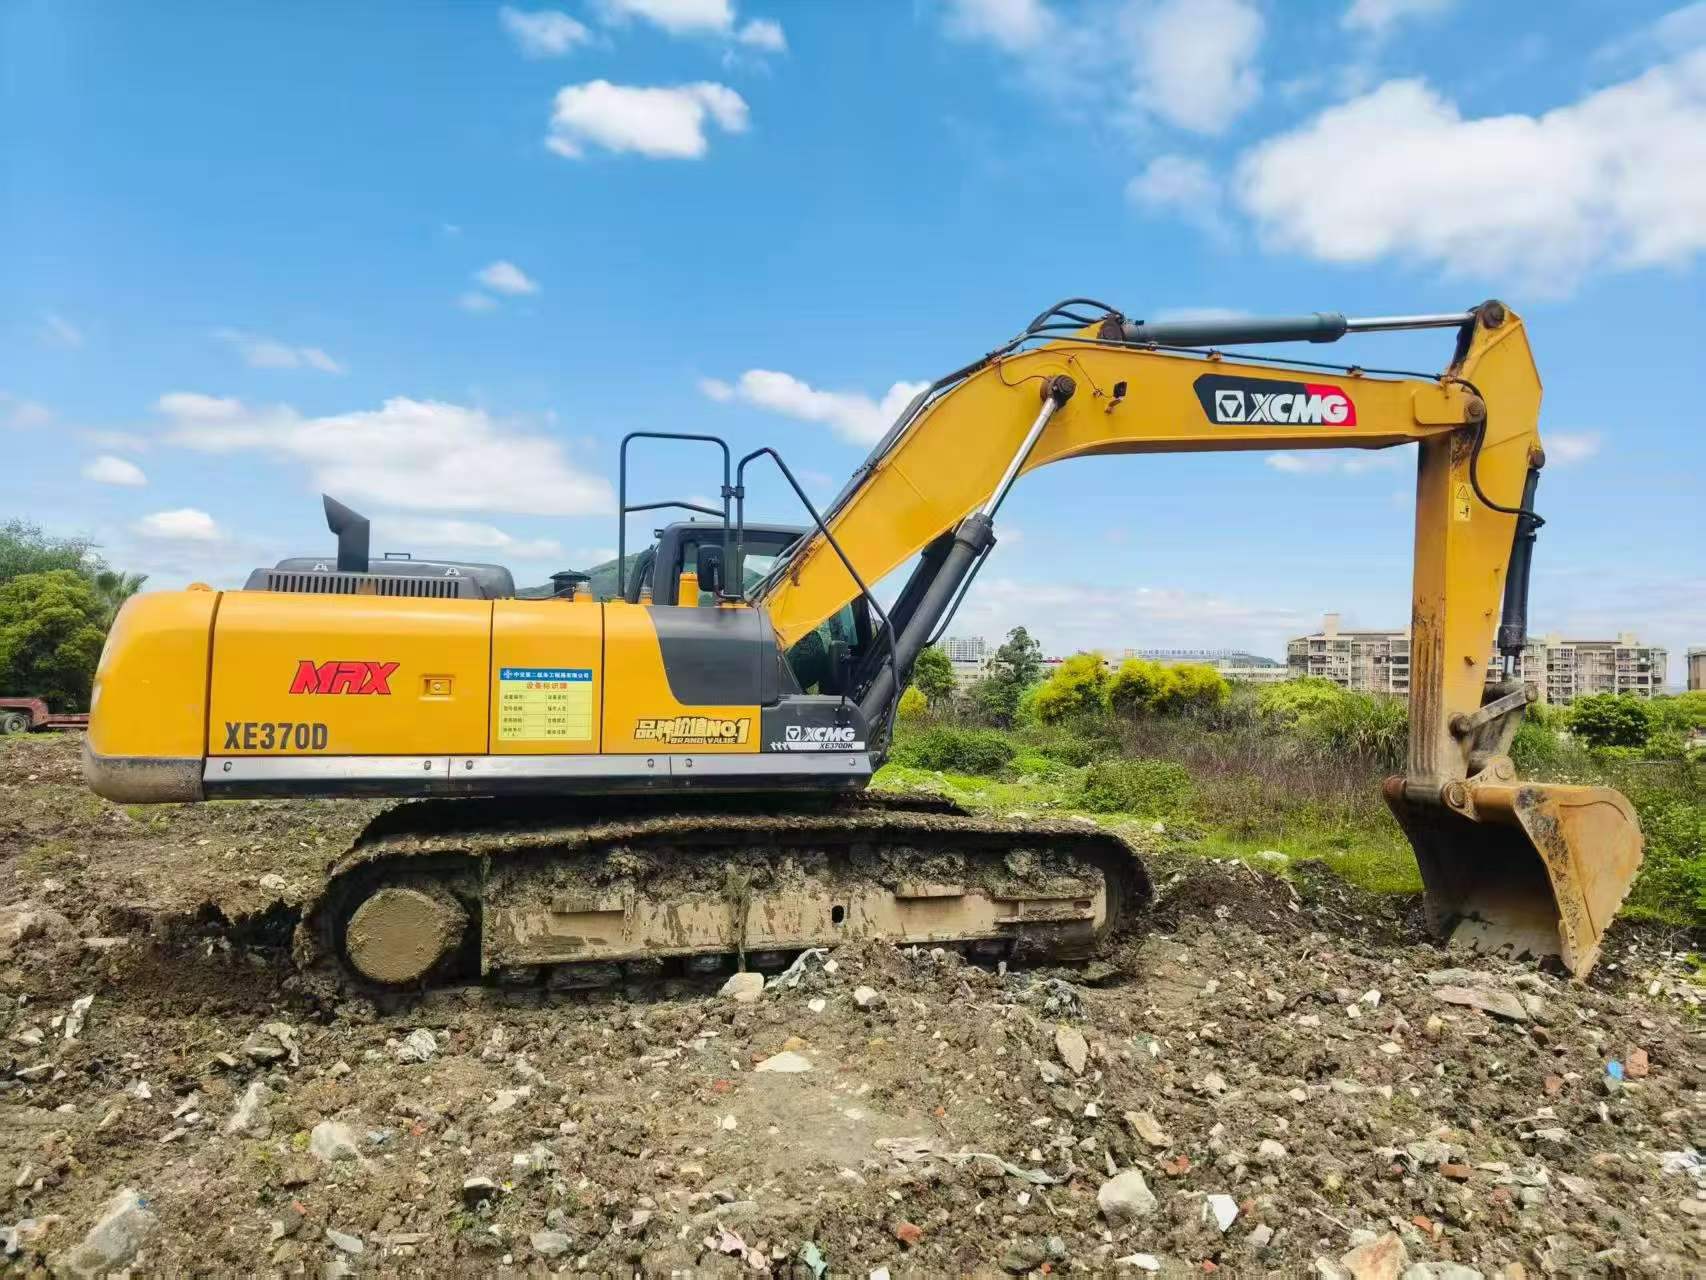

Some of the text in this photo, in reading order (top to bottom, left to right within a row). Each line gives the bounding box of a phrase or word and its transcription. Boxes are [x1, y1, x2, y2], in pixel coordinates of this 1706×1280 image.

[1246, 393, 1349, 424] XCMG
[289, 660, 400, 695] MAX
[224, 721, 329, 750] XE370D
[801, 727, 856, 742] XCMG
